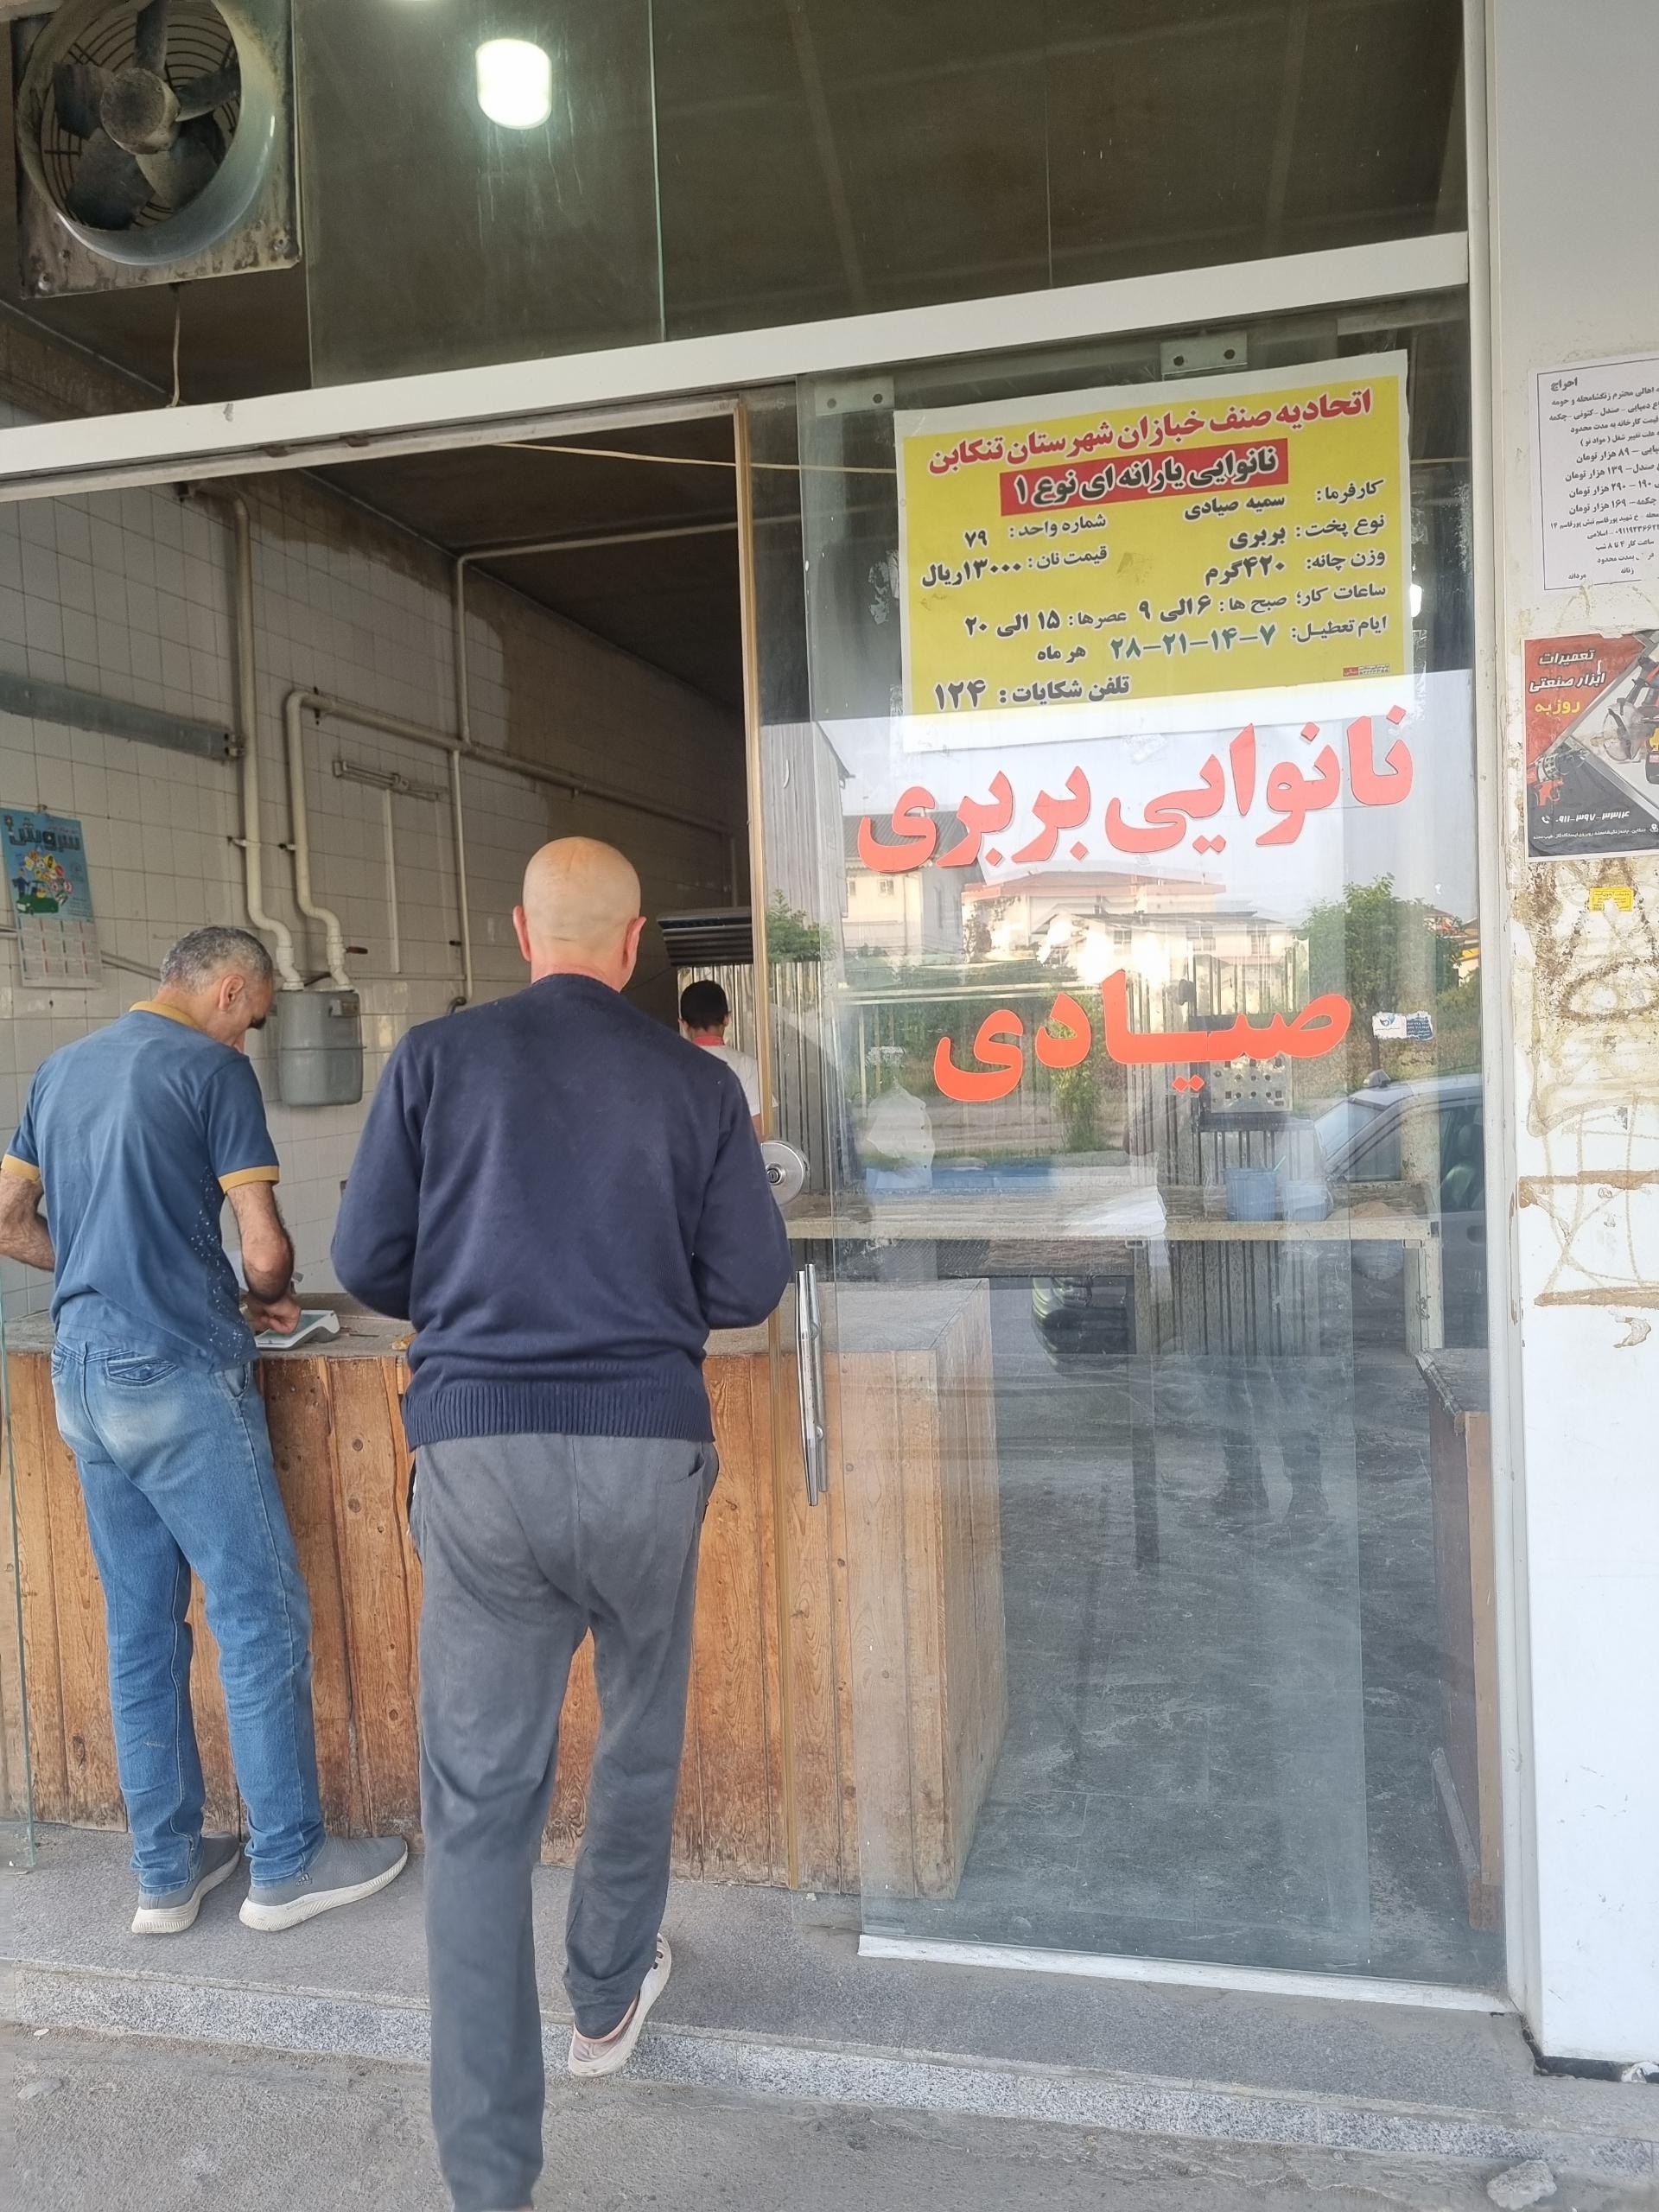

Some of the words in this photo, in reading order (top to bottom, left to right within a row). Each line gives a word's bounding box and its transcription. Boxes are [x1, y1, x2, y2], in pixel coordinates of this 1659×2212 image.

[1209, 406, 1272, 431] صنف
[1276, 389, 1371, 429] اتحادیه
[1117, 410, 1205, 449] خبازان
[1007, 422, 1114, 464] شهرستان
[929, 436, 1004, 474] تنکابن
[1576, 452, 1598, 464] تومان
[1599, 451, 1617, 461] هزار
[1119, 459, 1184, 492] یارانه
[1189, 447, 1276, 486] نانوایی
[1565, 470, 1586, 482] تومان
[1589, 468, 1605, 480] هزار
[1015, 475, 1027, 504] ۱
[1033, 470, 1077, 505] نوع
[1081, 463, 1115, 499] ای
[1592, 486, 1609, 496] هزار
[1568, 486, 1591, 499] تومان
[1185, 498, 1239, 520] صیادی
[1246, 495, 1286, 512] سمیه
[1568, 503, 1591, 516] تومان
[1592, 502, 1609, 513] هزار
[1062, 514, 1106, 535] شماره
[1354, 514, 1385, 537] نوع
[964, 529, 988, 549] ۷۹
[1230, 526, 1286, 550] بربری
[1064, 545, 1108, 565] قیمت
[1351, 549, 1385, 567] وزن
[1334, 582, 1387, 600] ساعات
[1139, 601, 1151, 620] ۹
[1250, 595, 1287, 613] صبح
[965, 617, 988, 636] ۲۰
[997, 613, 1029, 637] الی
[1037, 609, 1060, 631] ۱۵
[1357, 616, 1387, 638] ایام
[1037, 645, 1062, 661] ماه
[1066, 646, 1086, 663] هر
[1539, 650, 1595, 666] تعمیرات
[1088, 674, 1130, 702] تلفن
[1529, 677, 1574, 694] صنعتی
[1576, 671, 1606, 688] ابزار
[935, 679, 987, 710] ۱۲۴
[1535, 699, 1580, 715] روزبه
[1104, 704, 1414, 855] نانوایی
[857, 766, 1092, 874] بربری
[933, 968, 1352, 1103] صیادی
